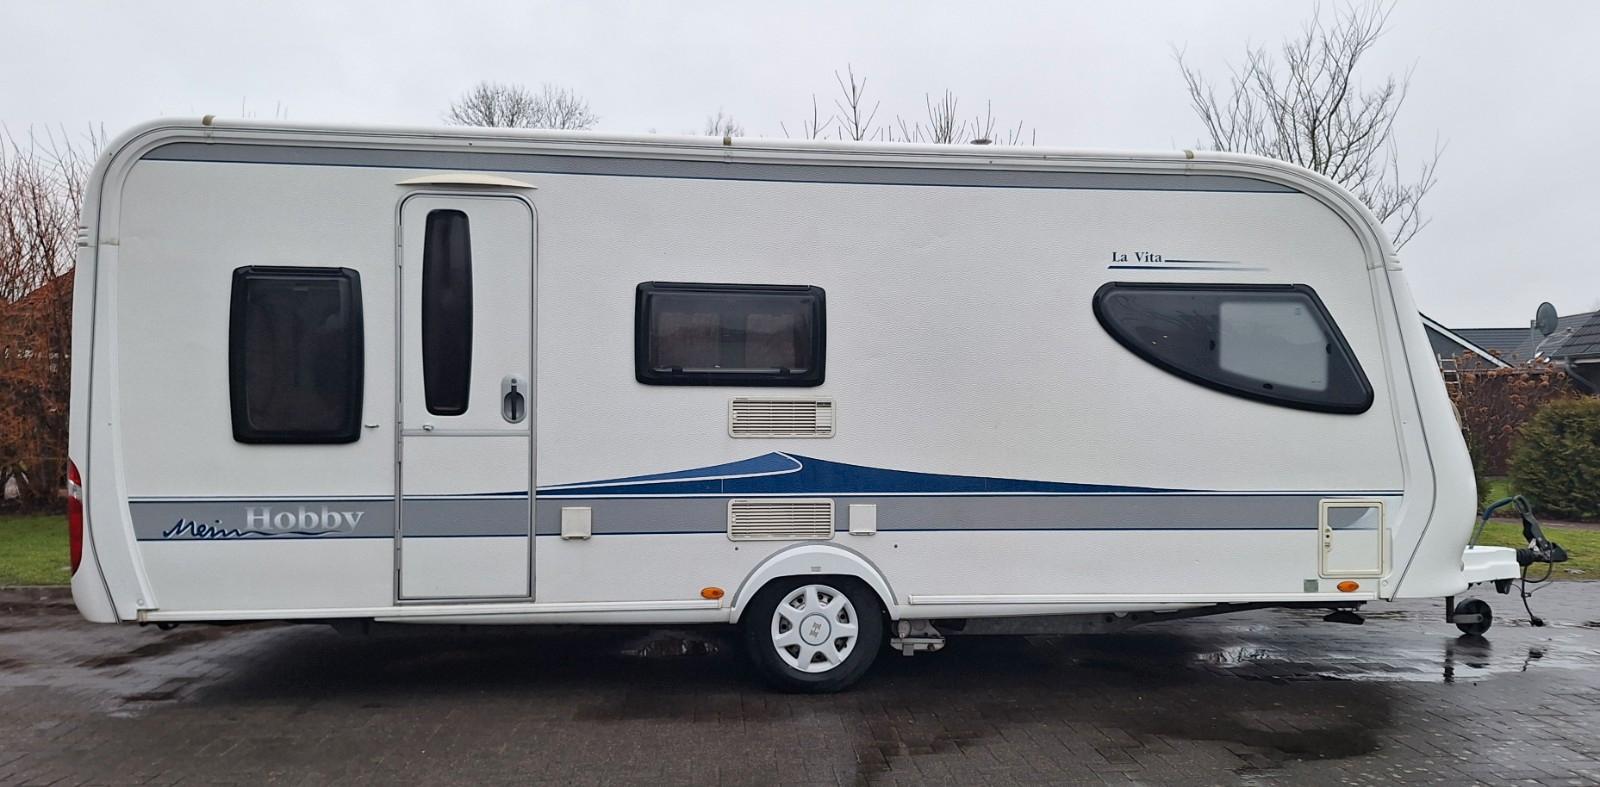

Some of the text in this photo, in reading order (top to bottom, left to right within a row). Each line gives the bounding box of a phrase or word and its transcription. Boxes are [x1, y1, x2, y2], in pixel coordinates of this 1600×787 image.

[1111, 251, 1163, 264] La Vita
[163, 505, 365, 538] Mein Hobby
